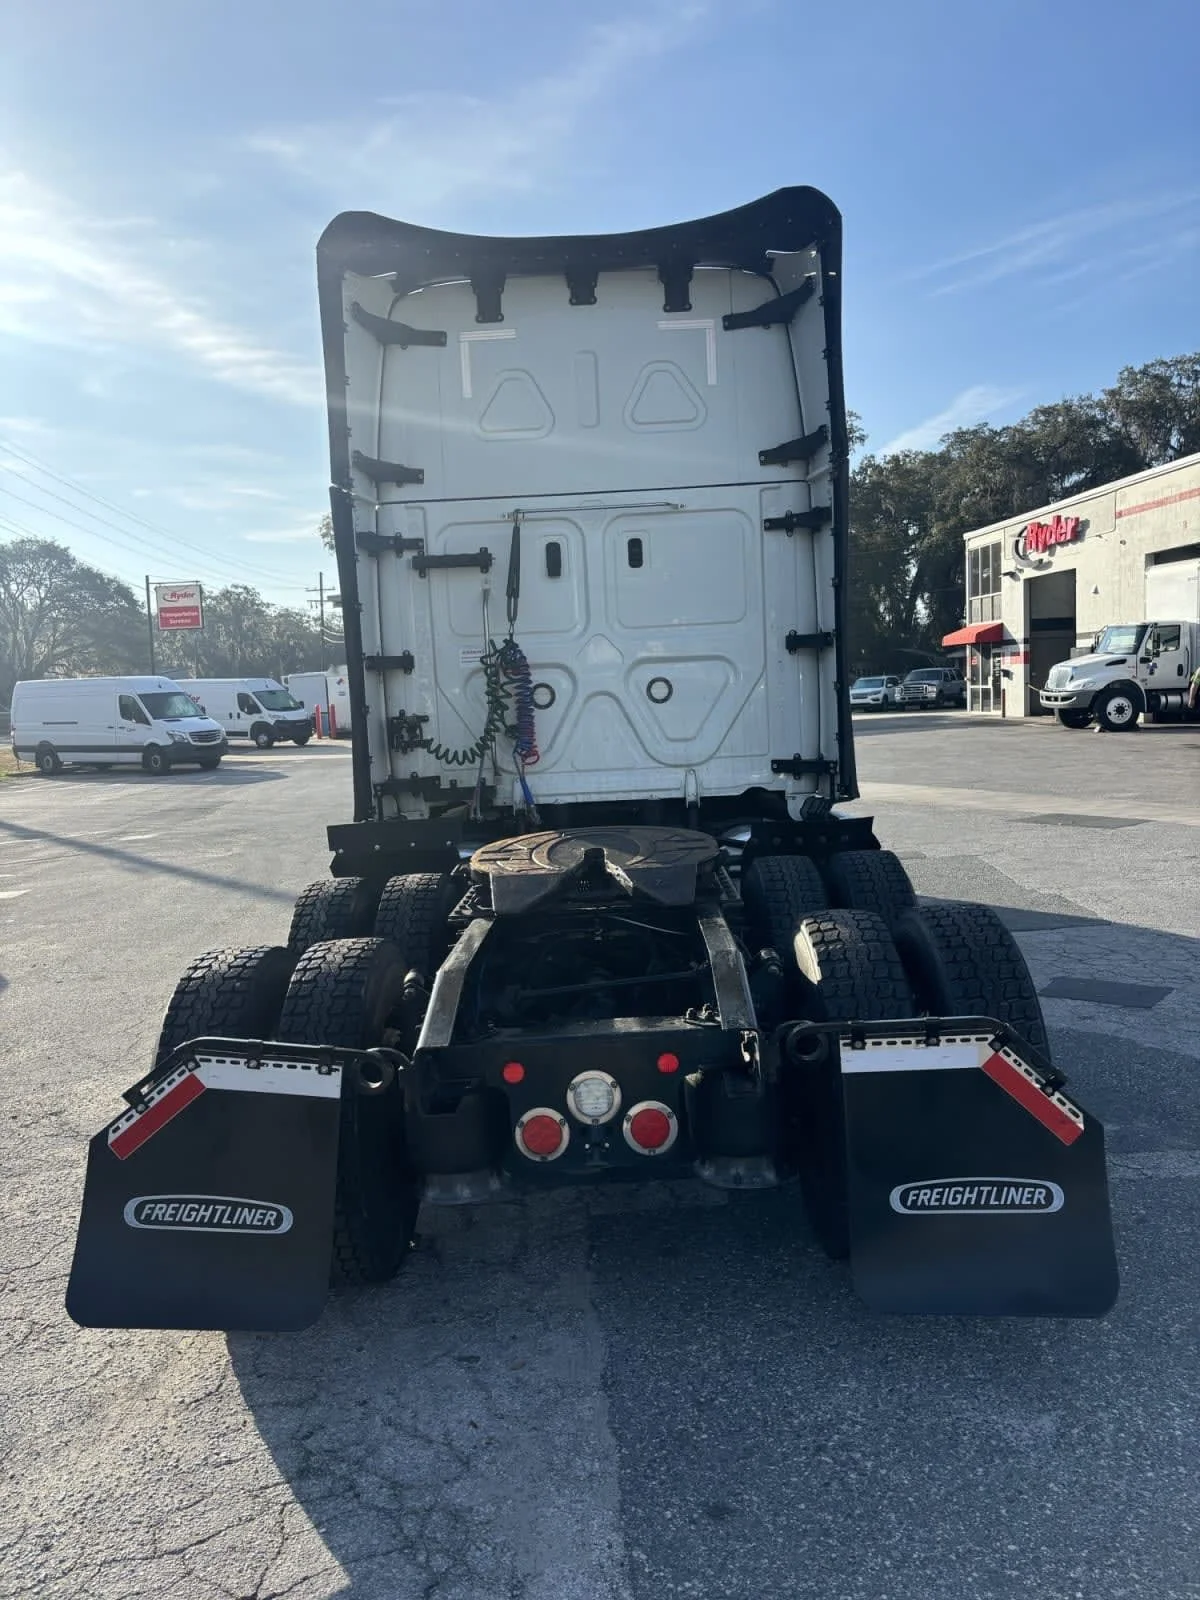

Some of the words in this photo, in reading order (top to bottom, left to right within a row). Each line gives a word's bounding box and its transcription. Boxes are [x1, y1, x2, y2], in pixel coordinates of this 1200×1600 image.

[1025, 515, 1080, 554] Ryder
[170, 591, 196, 600] Ryder
[906, 1186, 1047, 1207] FREIGHTLINER
[140, 1203, 278, 1227] FREIGHTLINER
